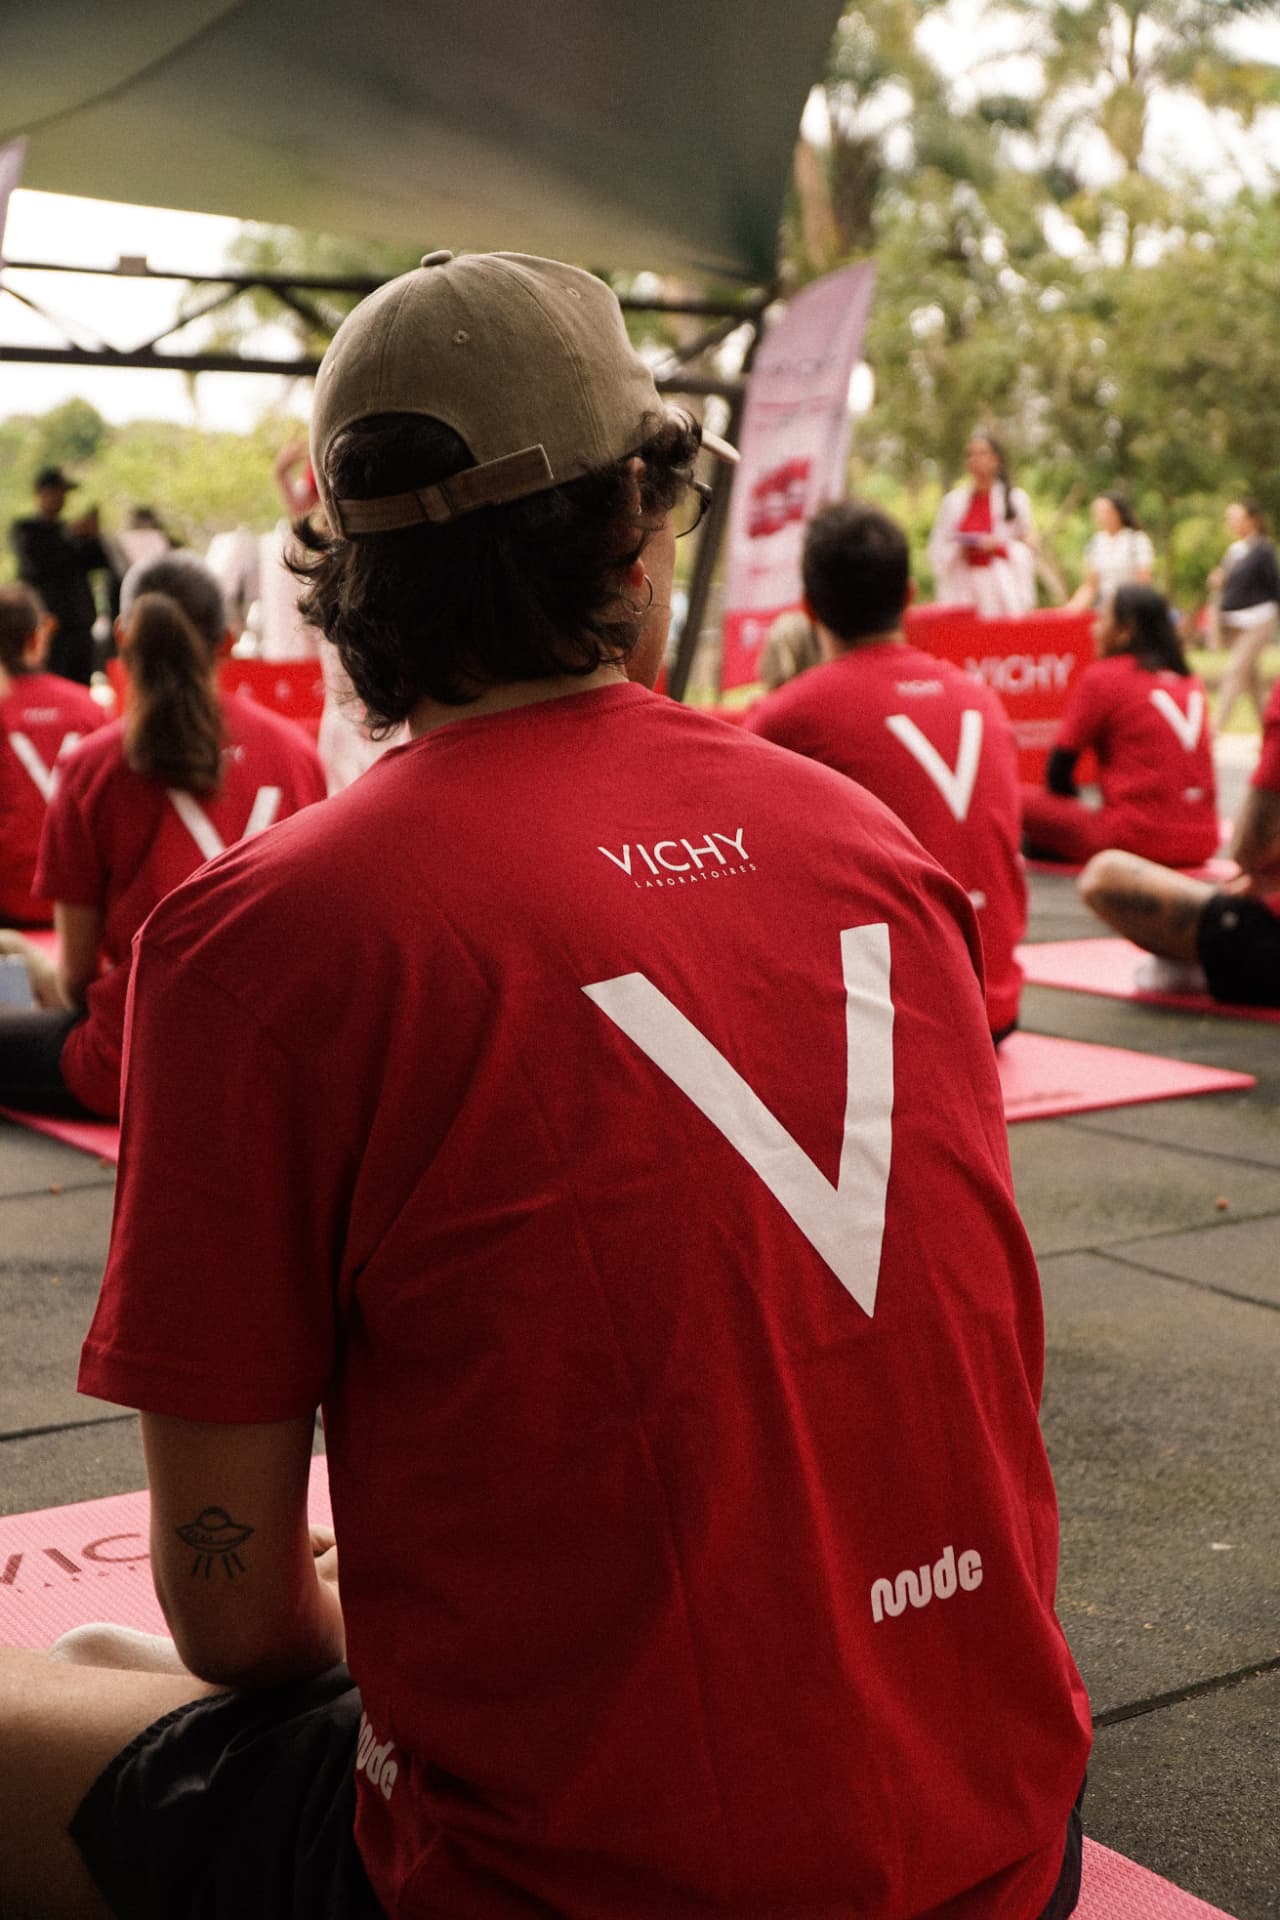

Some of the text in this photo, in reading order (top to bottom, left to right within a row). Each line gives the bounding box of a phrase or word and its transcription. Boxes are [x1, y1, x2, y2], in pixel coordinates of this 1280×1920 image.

[1150, 688, 1204, 752] V
[885, 709, 983, 823] V
[597, 827, 749, 876] VICHY
[634, 863, 757, 888] LABORATOIRES
[580, 922, 895, 1319] V
